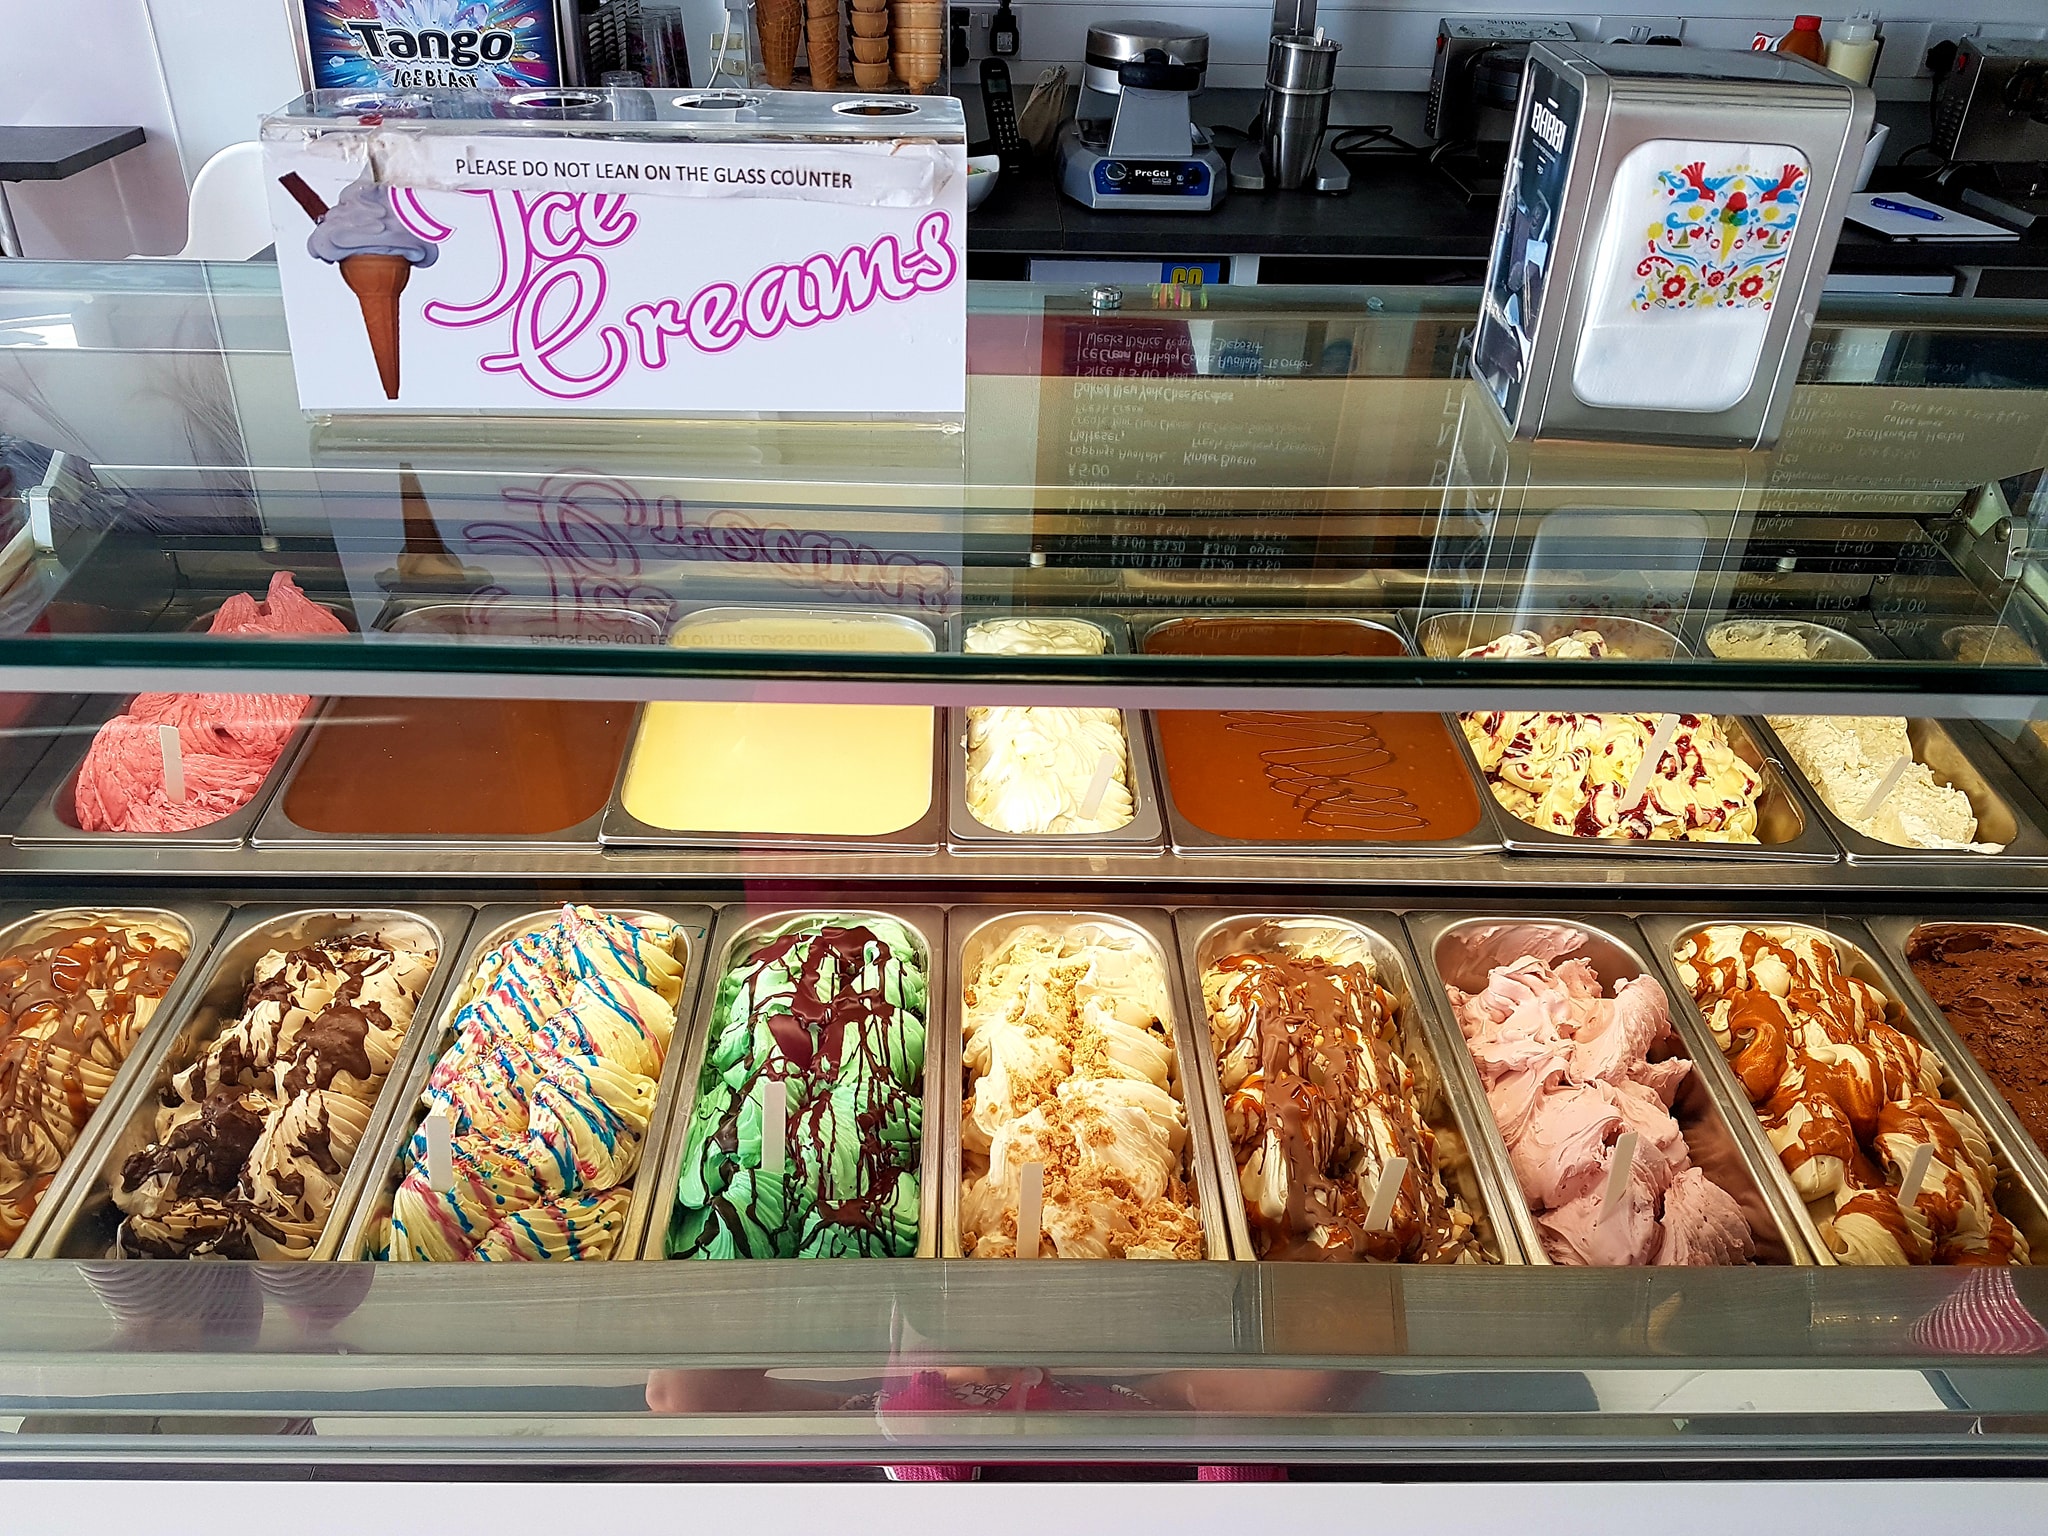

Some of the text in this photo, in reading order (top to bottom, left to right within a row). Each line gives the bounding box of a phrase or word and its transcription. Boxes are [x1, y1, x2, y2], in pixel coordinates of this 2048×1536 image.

[346, 20, 514, 68] Tango
[1530, 100, 1568, 154] BABBI
[456, 159, 853, 189] PLEASE DO NOT LEAN ON THE GLASS COUNTER
[1134, 169, 1169, 178] PreGel
[389, 187, 639, 327] Ice
[479, 210, 958, 399] Creams
